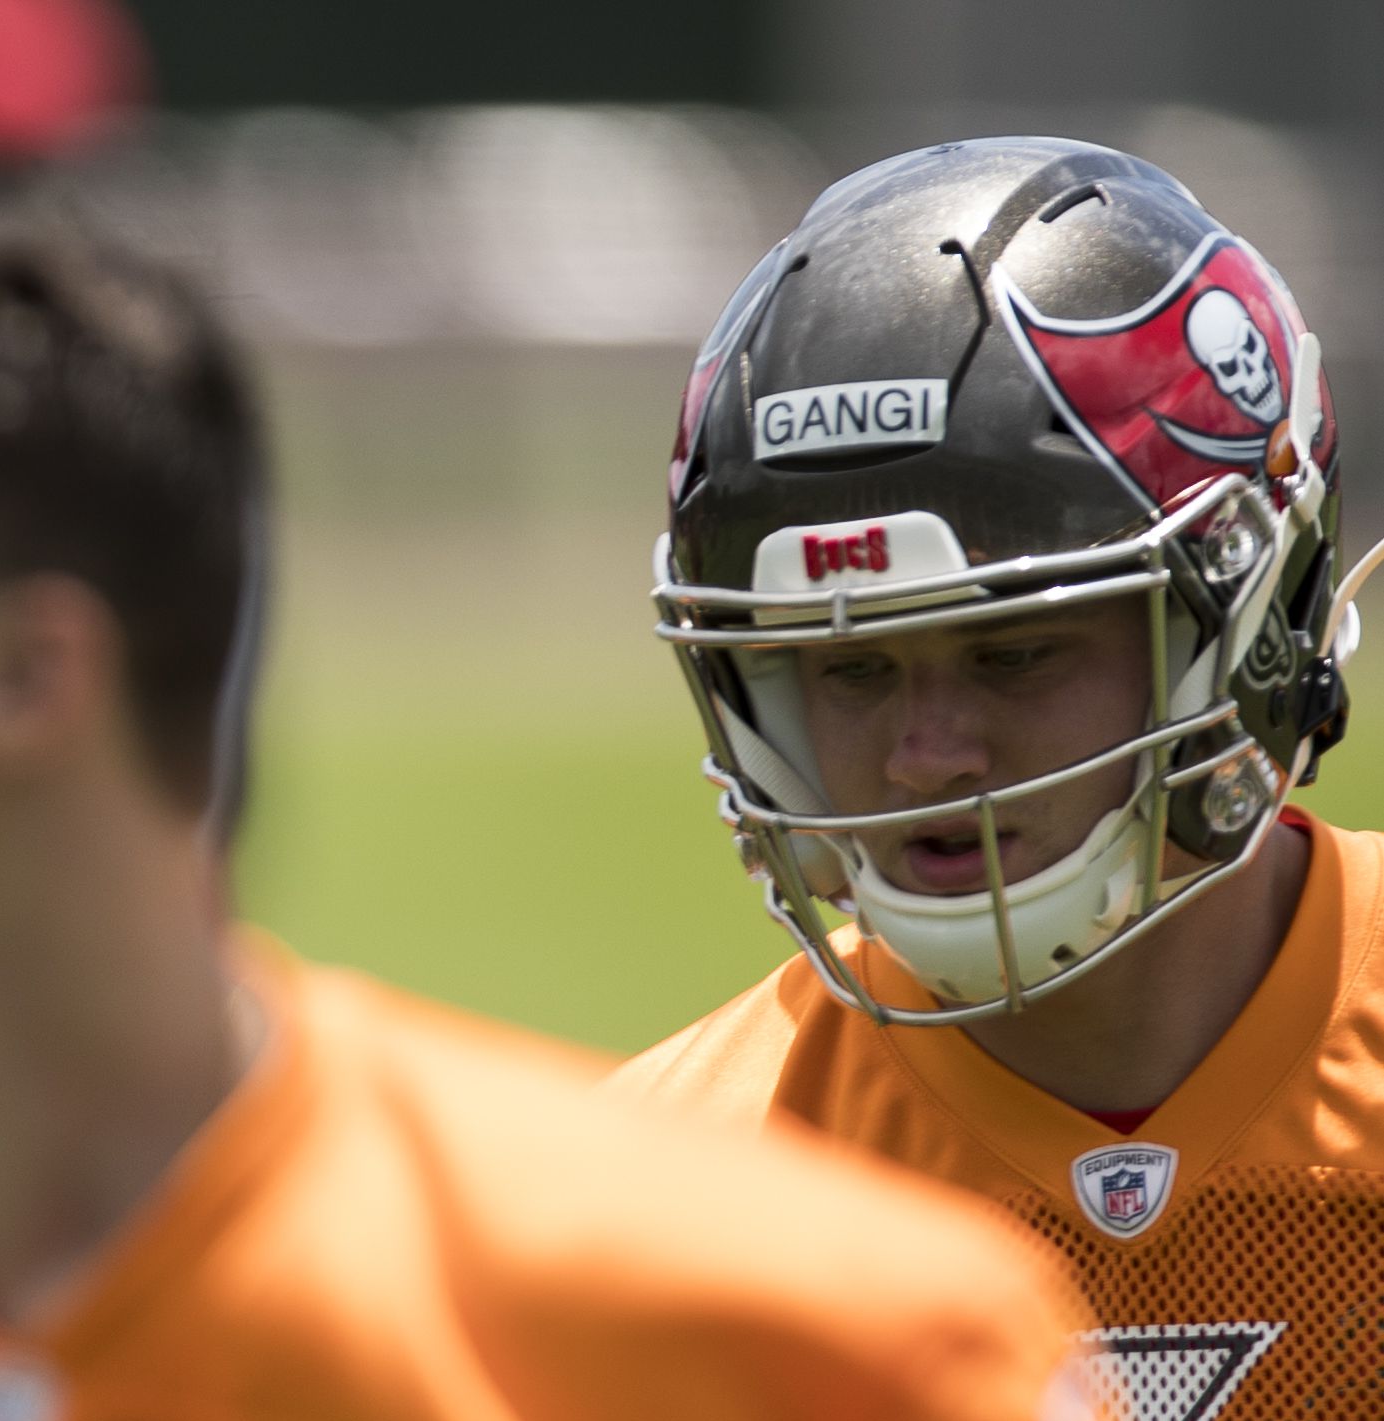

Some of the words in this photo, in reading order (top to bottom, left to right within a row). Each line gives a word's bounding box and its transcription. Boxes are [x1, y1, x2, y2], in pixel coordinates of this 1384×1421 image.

[763, 387, 930, 446] GANGI
[1084, 1153, 1166, 1176] EQUIPMENT
[1105, 1189, 1145, 1217] NFL
